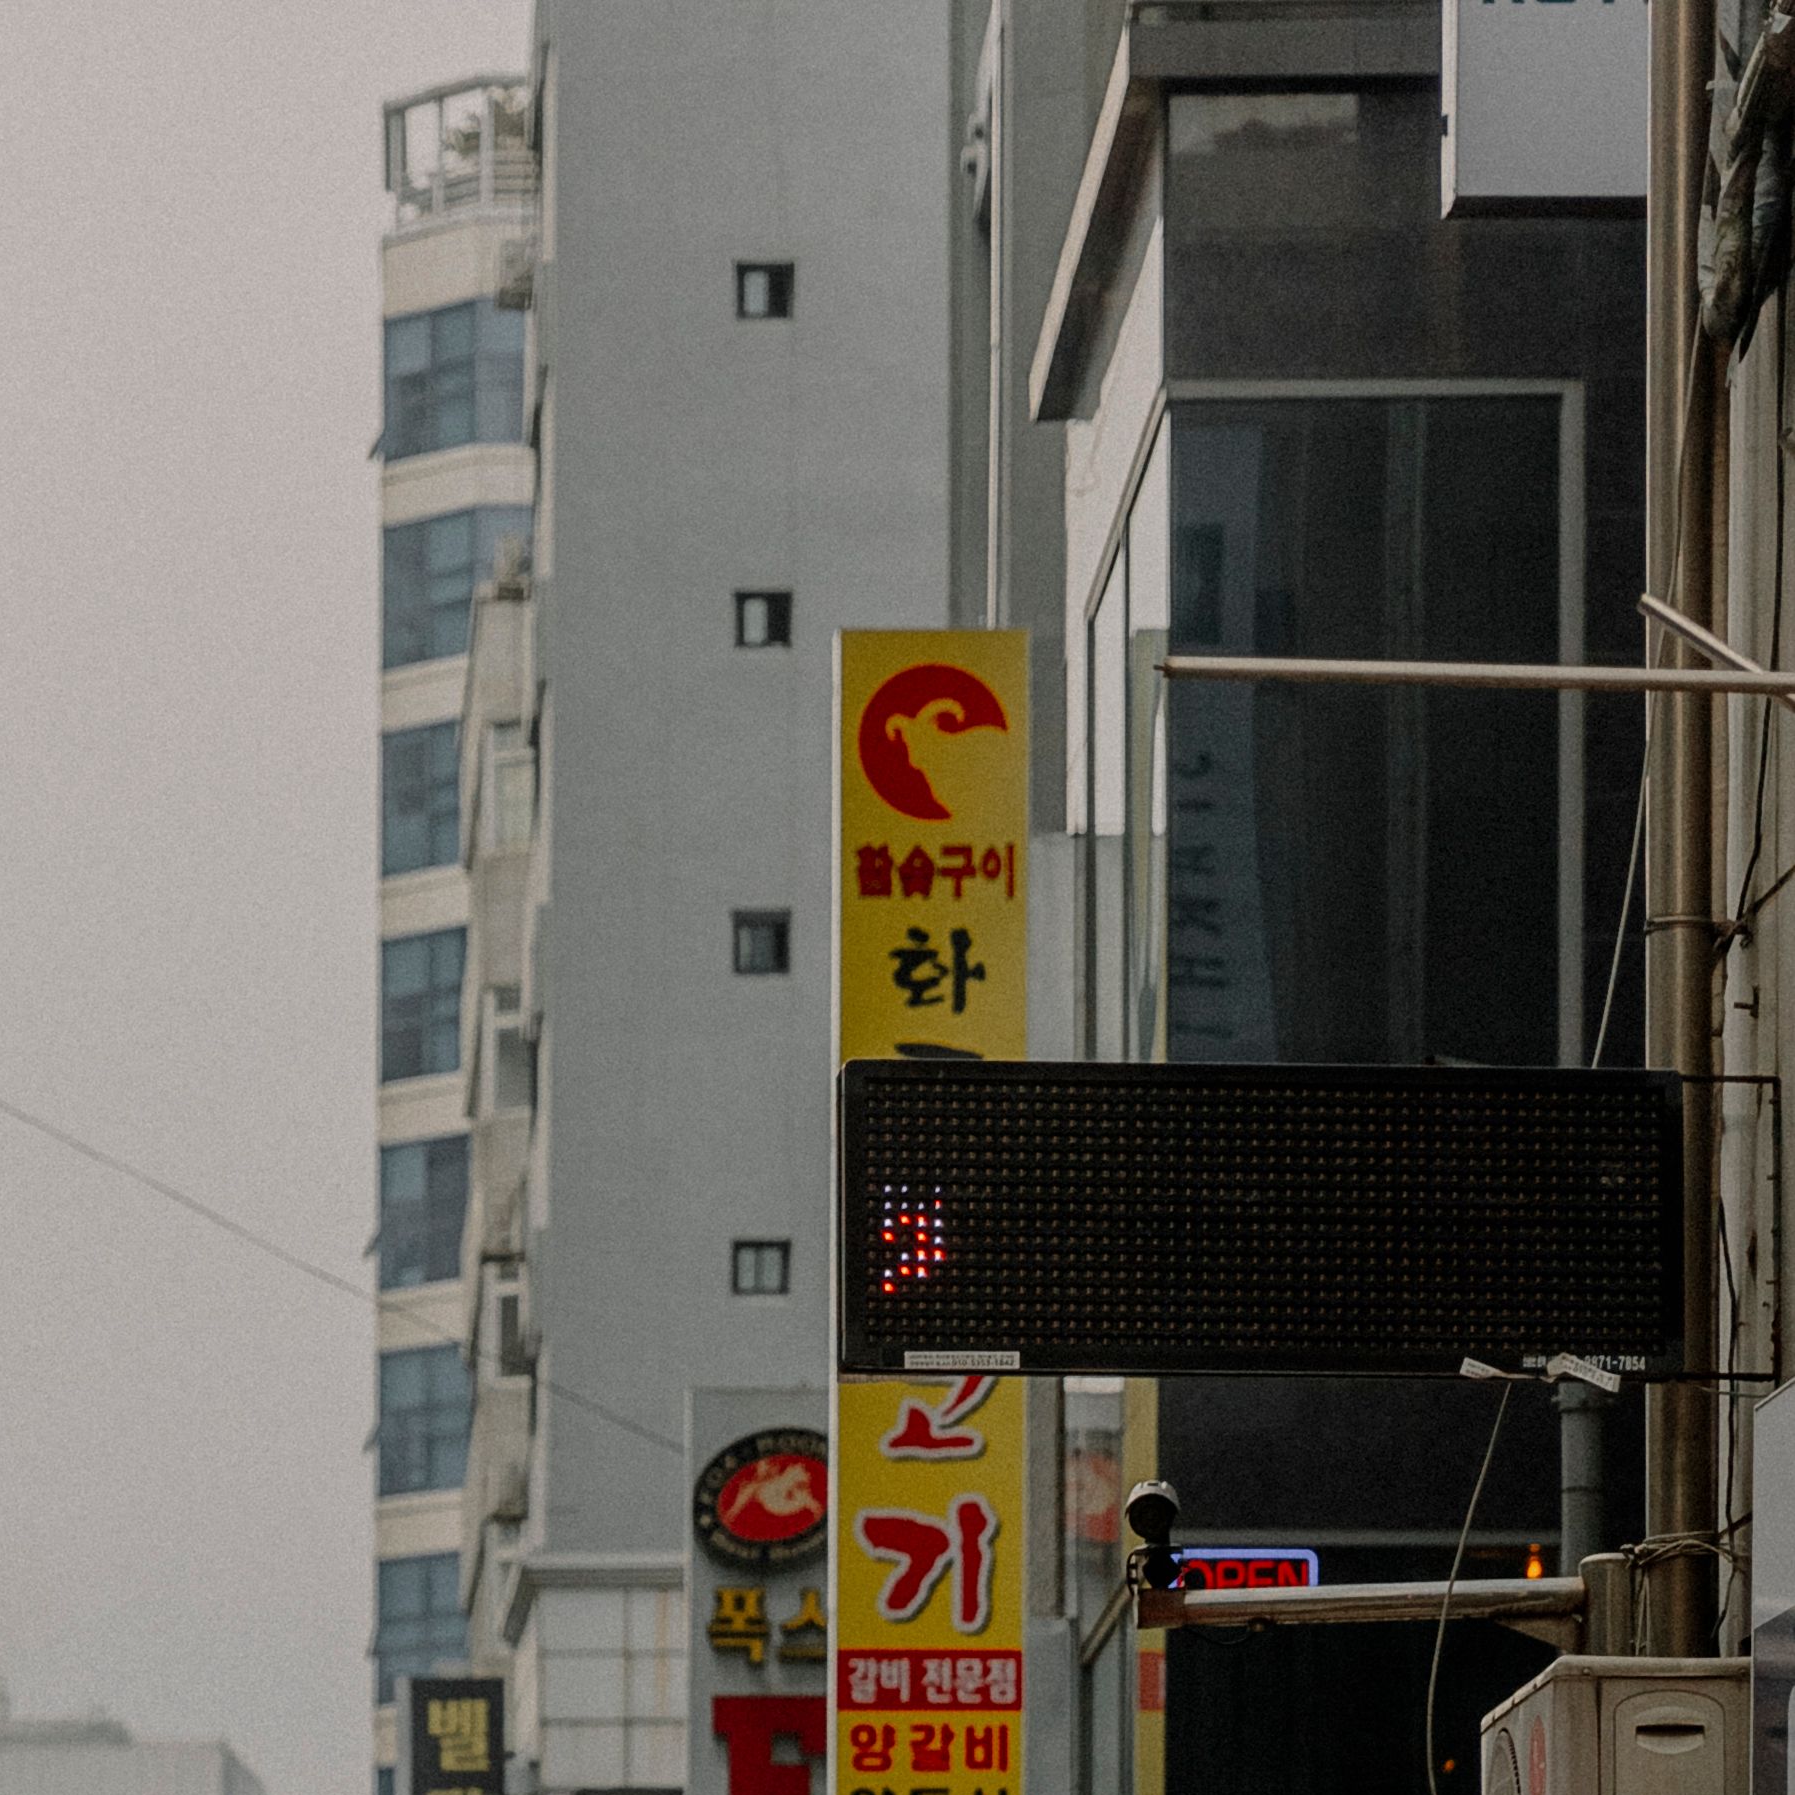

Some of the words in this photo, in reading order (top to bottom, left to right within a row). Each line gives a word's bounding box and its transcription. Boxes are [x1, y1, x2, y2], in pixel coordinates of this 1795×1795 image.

[891, 925, 986, 1060] 화
[1180, 1558, 1308, 1590] OPEN
[847, 1656, 911, 1704] 갈비
[921, 1656, 1017, 1705] 전문점
[849, 1723, 1009, 1772] 양갈비
